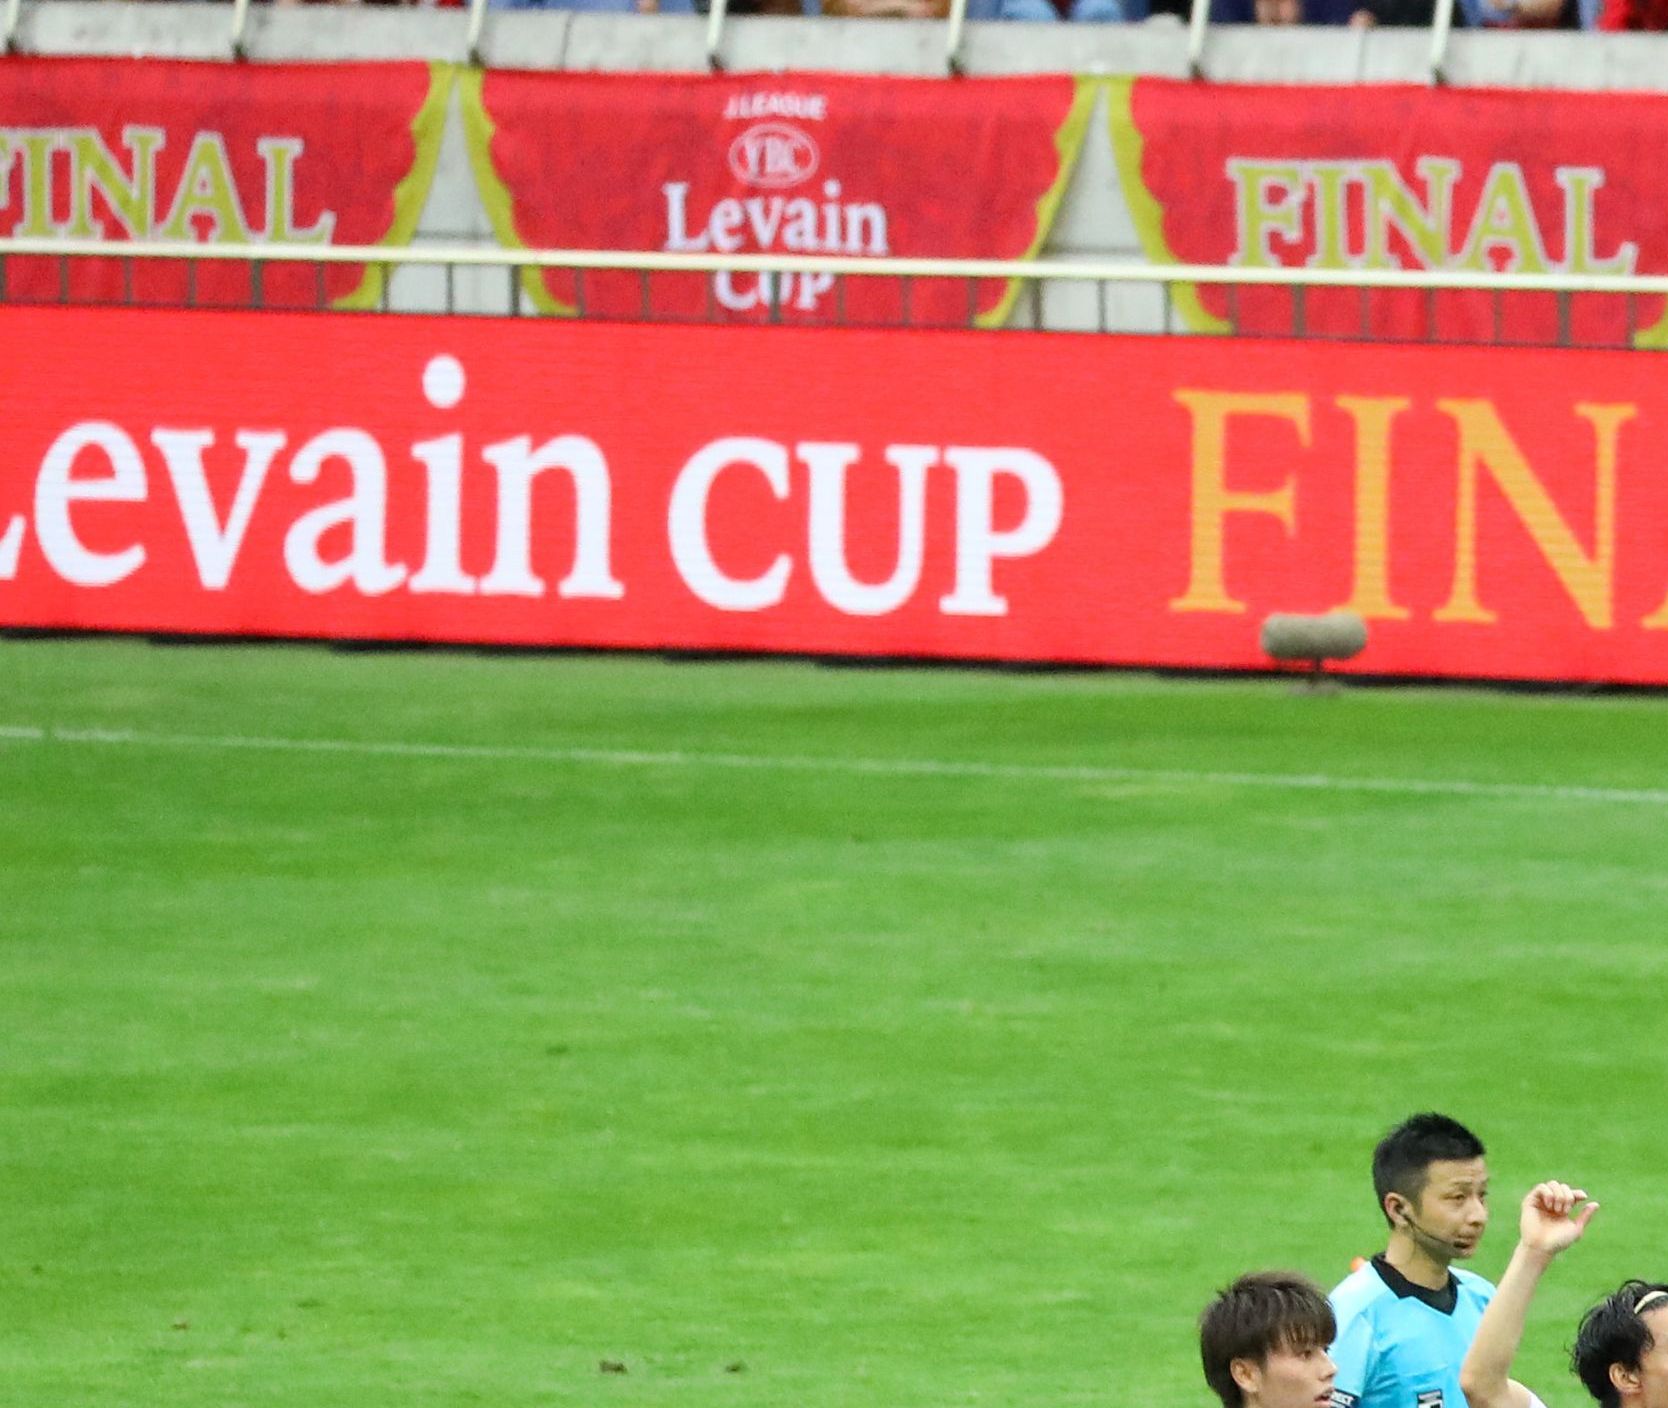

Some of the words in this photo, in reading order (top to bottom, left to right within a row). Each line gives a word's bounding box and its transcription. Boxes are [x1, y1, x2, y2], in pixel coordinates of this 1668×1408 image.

[0, 124, 337, 246] INAL
[662, 178, 889, 256] Levain
[1226, 156, 1638, 276] FINAL
[714, 266, 836, 311] CUP
[0, 355, 625, 599] evain
[668, 437, 1065, 617] CUP
